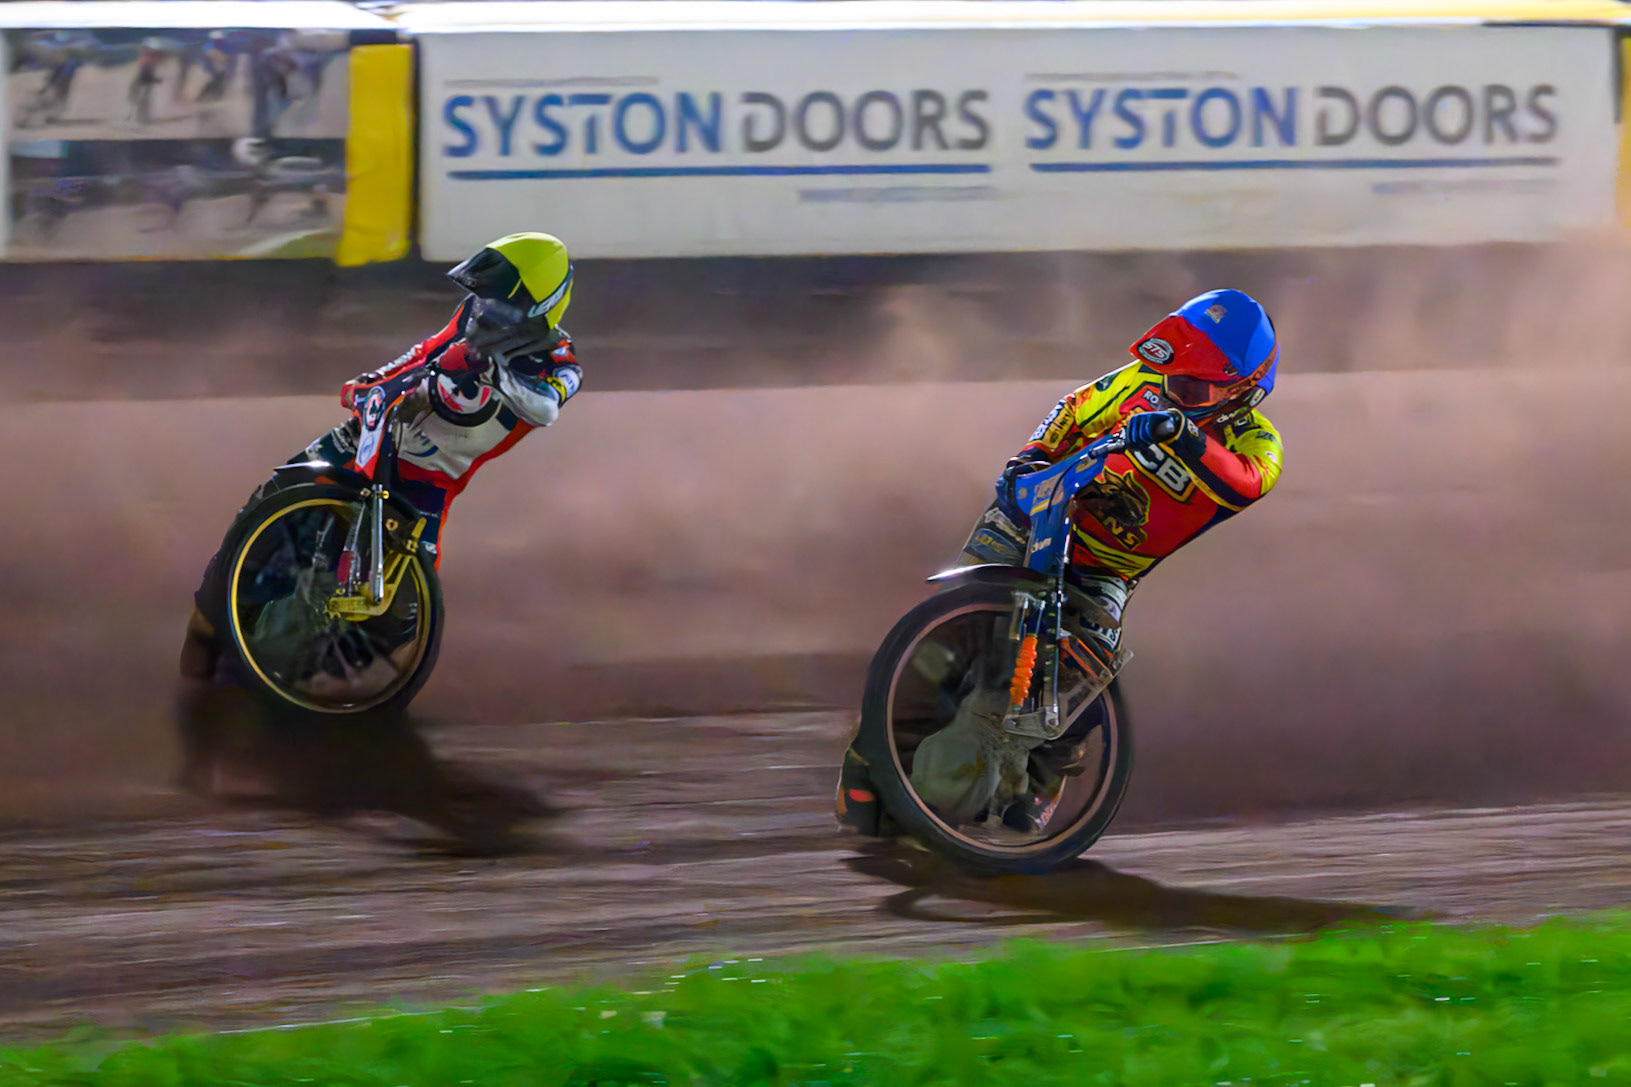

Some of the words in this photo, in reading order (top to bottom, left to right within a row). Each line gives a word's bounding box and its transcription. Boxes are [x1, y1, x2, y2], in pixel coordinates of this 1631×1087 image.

[444, 92, 722, 157] SYSTON
[741, 90, 990, 152] DOORS
[1024, 87, 1297, 150] SYSTON
[1315, 84, 1558, 146] DOORS
[1133, 442, 1192, 492] CB
